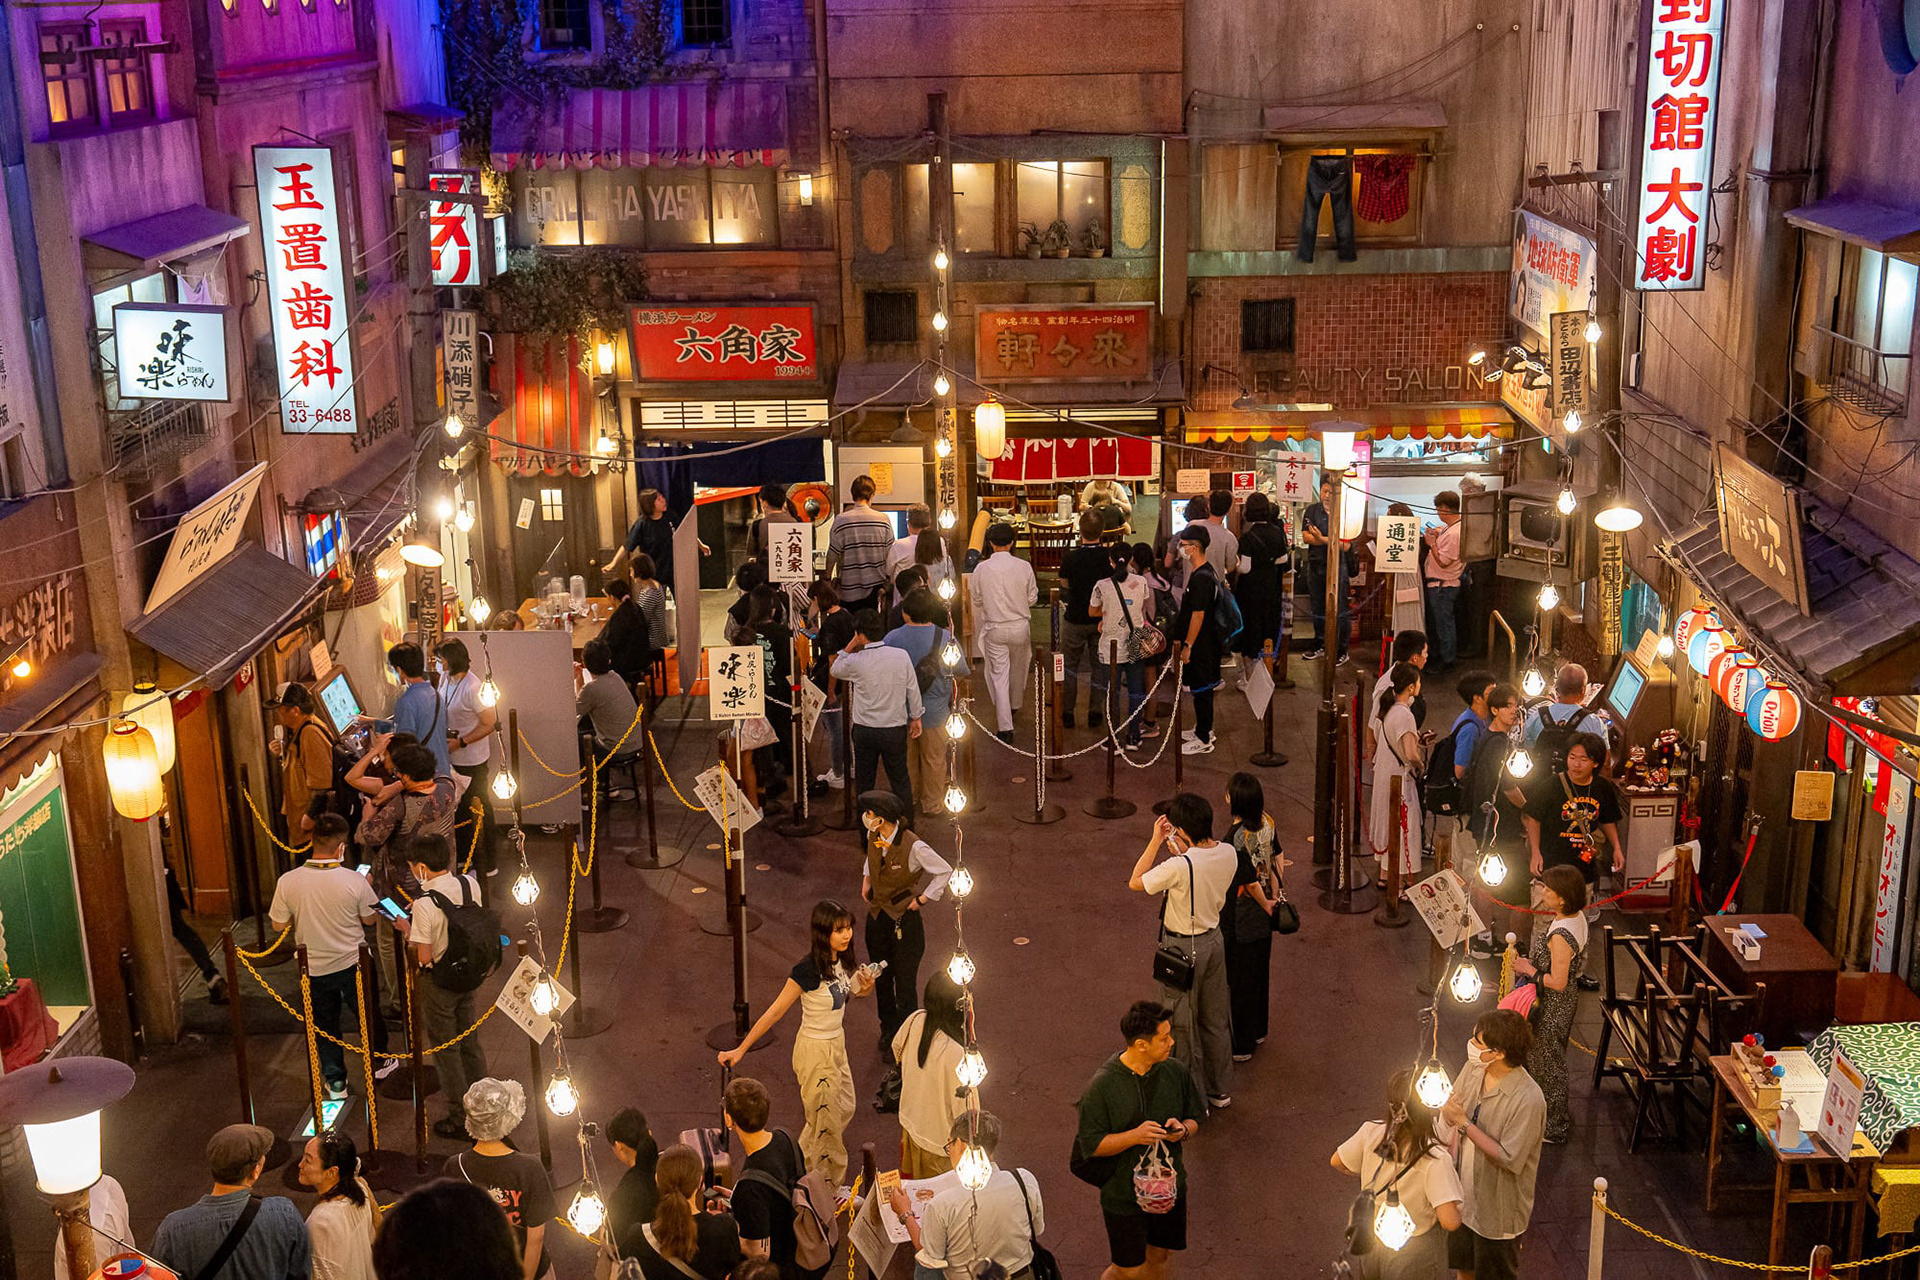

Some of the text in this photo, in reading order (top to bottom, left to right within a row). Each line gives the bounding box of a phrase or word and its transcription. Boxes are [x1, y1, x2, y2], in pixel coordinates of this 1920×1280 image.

[1641, 167, 1704, 282] 大劇
[272, 163, 343, 390] 玉置歯科
[637, 311, 717, 325] 横浜ラーメン
[673, 323, 807, 364] 六角家
[449, 317, 474, 412] 川添硝子
[1254, 366, 1484, 393] BEAUTY SALON
[289, 400, 310, 408] TEL
[289, 409, 352, 423] 33-6488
[787, 528, 804, 573] 六角家
[1385, 522, 1406, 563] 通堂
[1762, 701, 1779, 734] Orion
